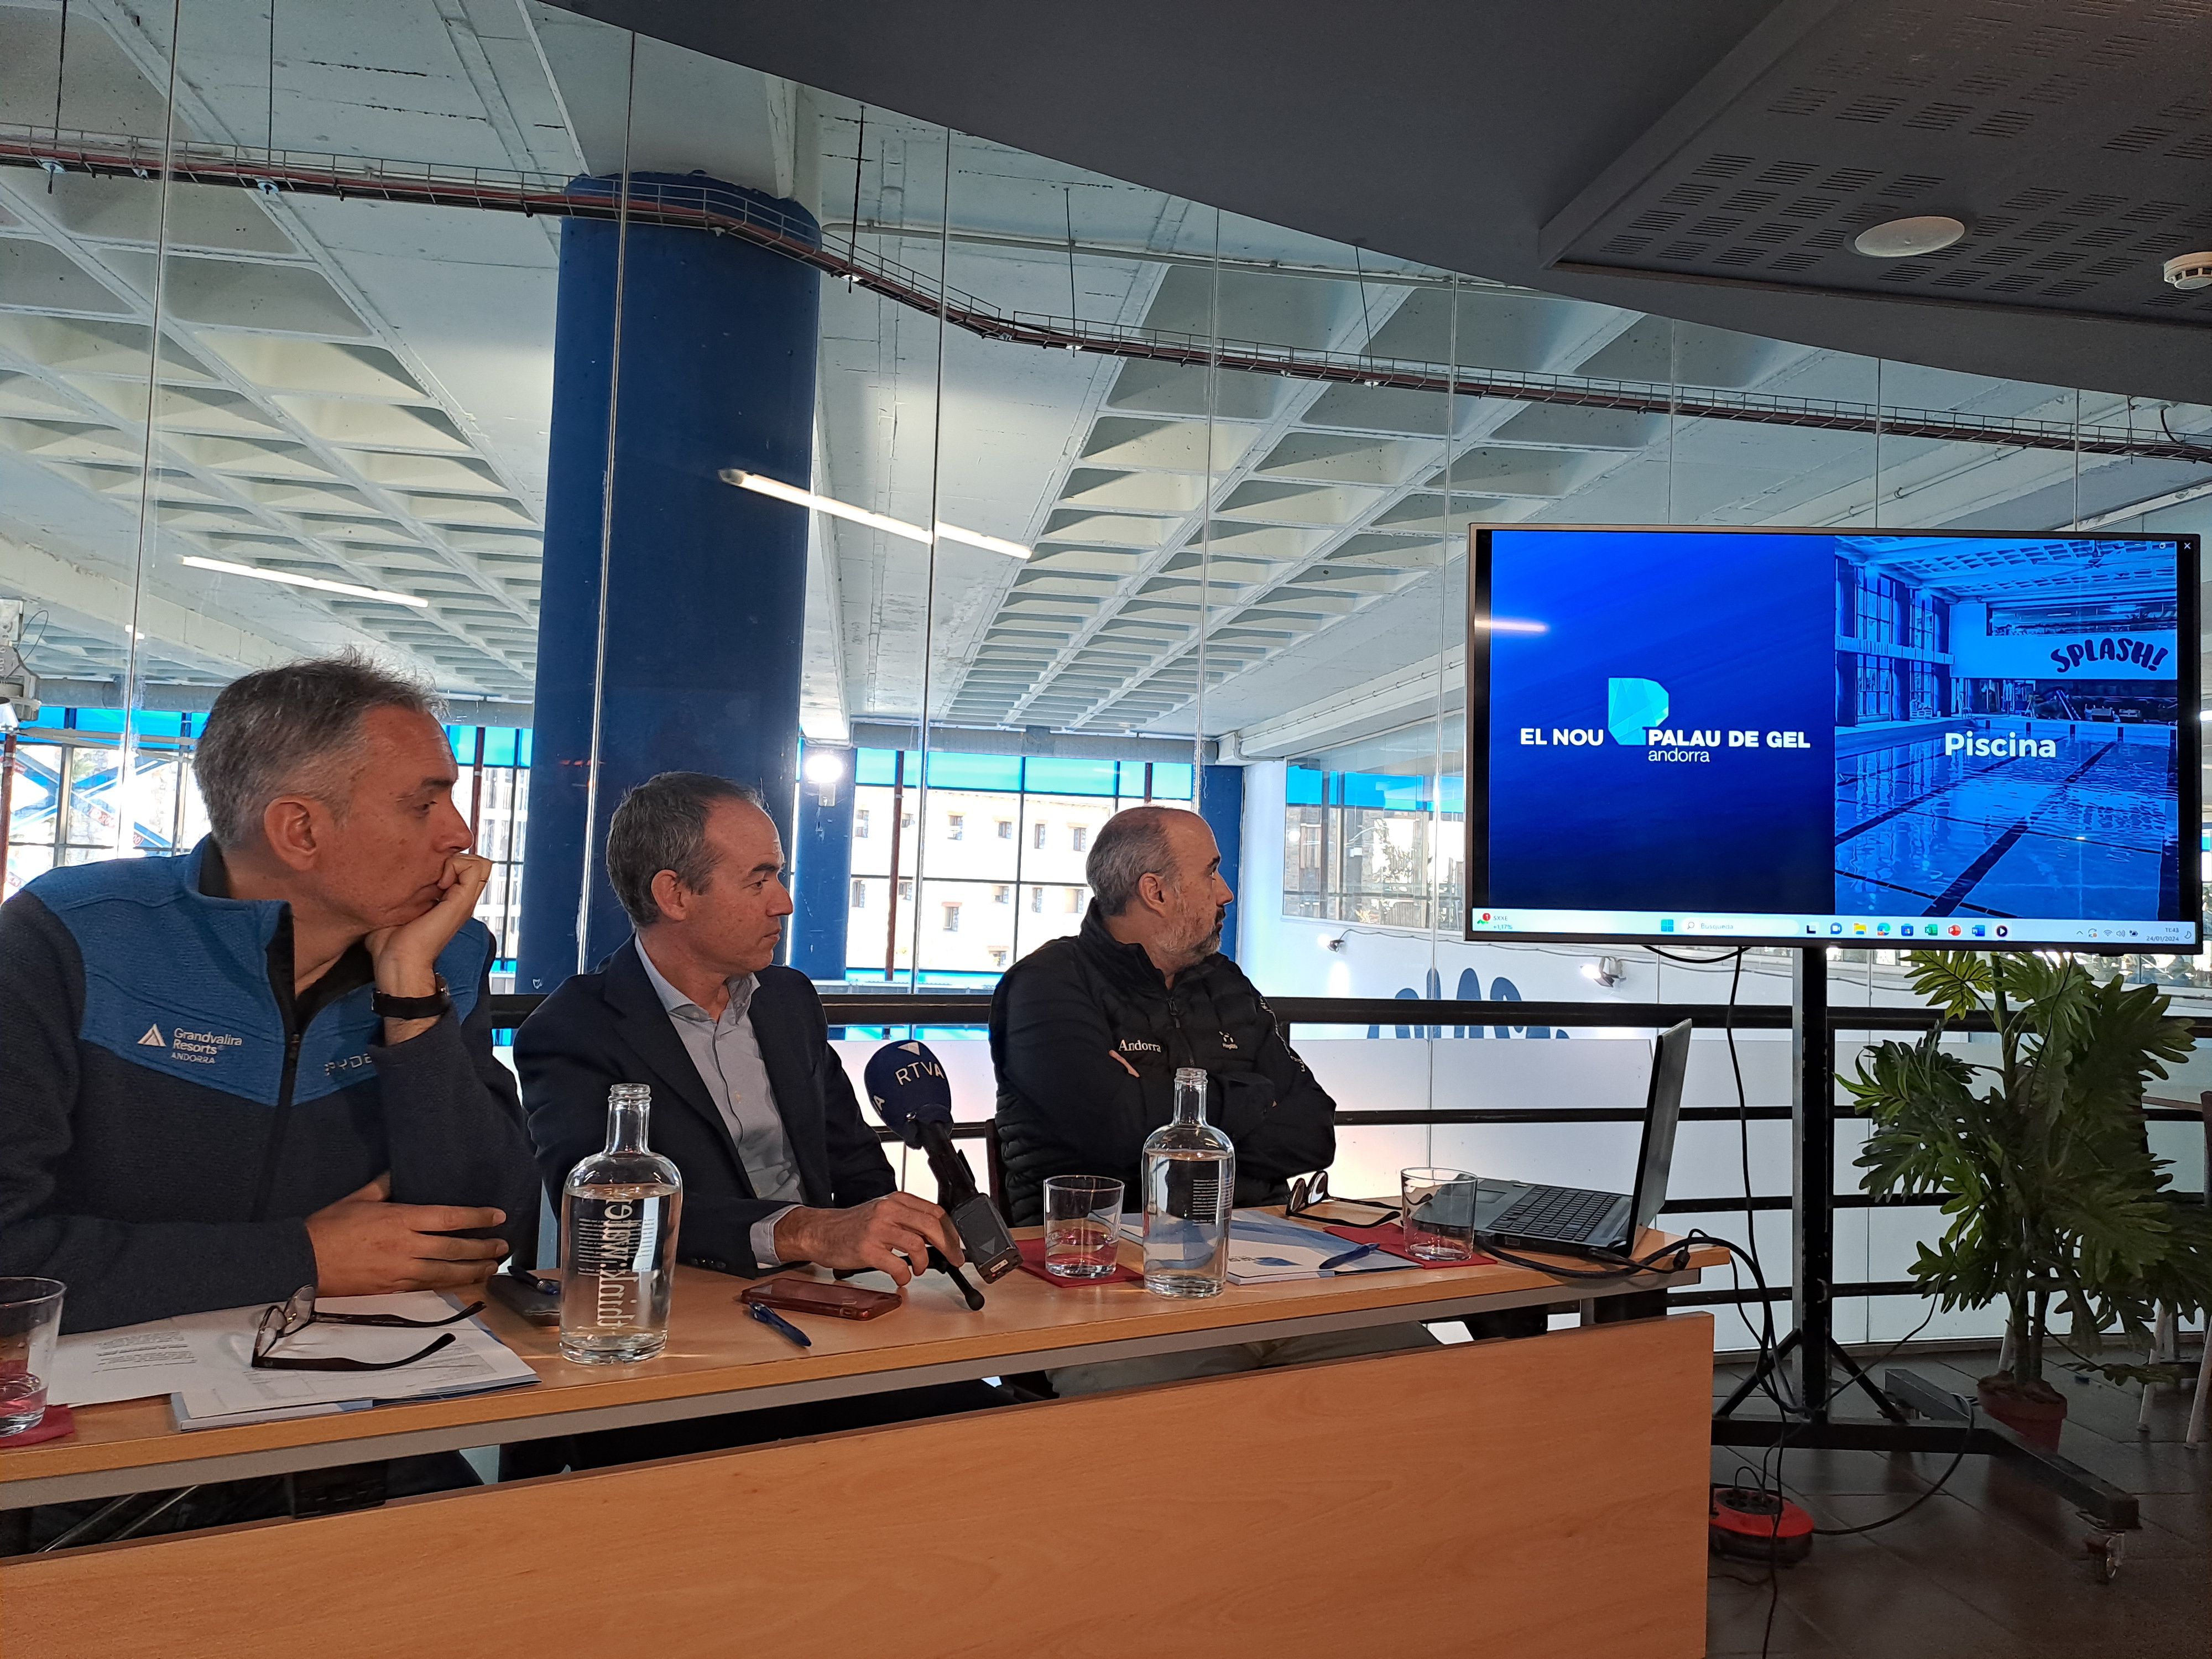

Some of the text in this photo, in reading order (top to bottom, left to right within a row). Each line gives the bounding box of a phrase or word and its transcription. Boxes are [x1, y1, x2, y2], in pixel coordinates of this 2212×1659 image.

[2051, 638, 2168, 673] SPLASH!
[1520, 728, 1811, 748] EL NOU PALAU DE GEL
[1945, 731, 2057, 758] Piscina
[1648, 748, 1710, 763] andorra
[174, 1027, 243, 1046] Grandvalira
[1118, 1039, 1161, 1053] Andorra
[173, 1039, 217, 1055] Resorts
[171, 1052, 216, 1064] ANDORRA
[895, 1061, 945, 1086] RTVA
